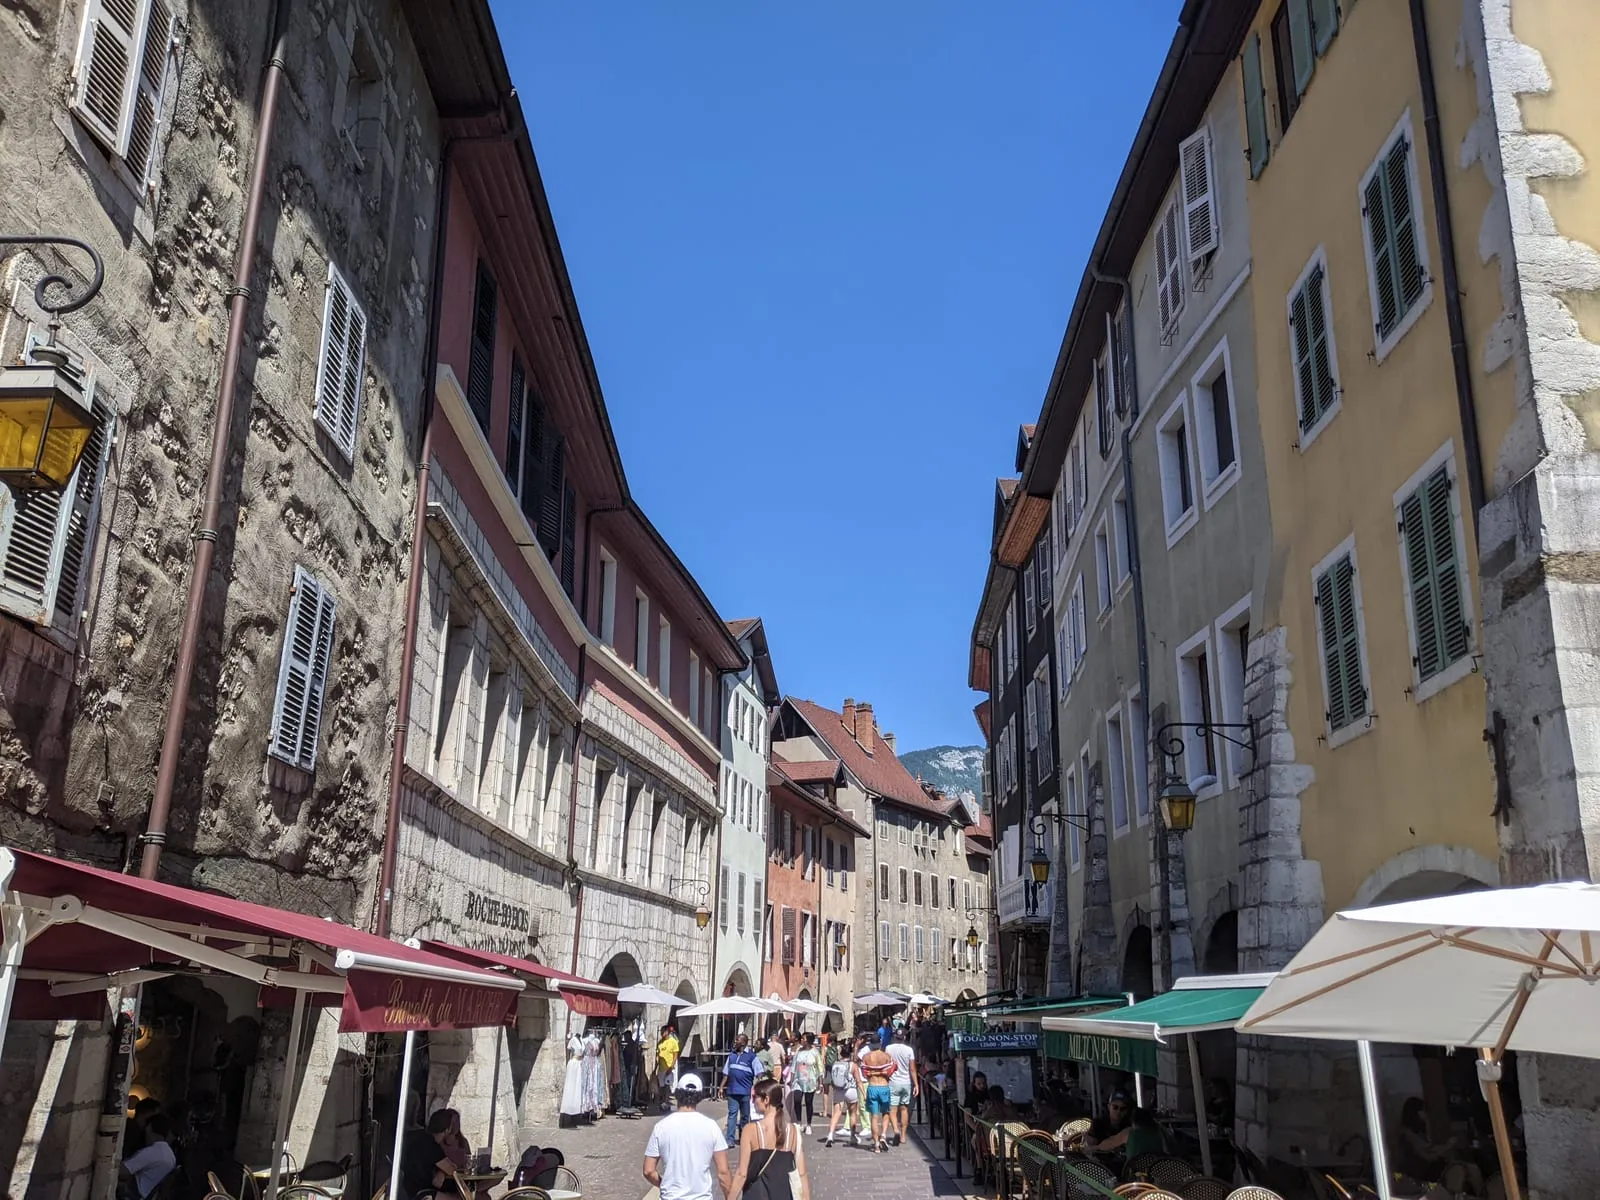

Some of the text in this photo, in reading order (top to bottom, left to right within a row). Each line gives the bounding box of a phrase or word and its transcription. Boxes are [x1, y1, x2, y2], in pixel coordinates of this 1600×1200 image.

[958, 1034, 1038, 1043] FOOD NON-STOP
[1068, 1034, 1120, 1066] MILTON PUB
